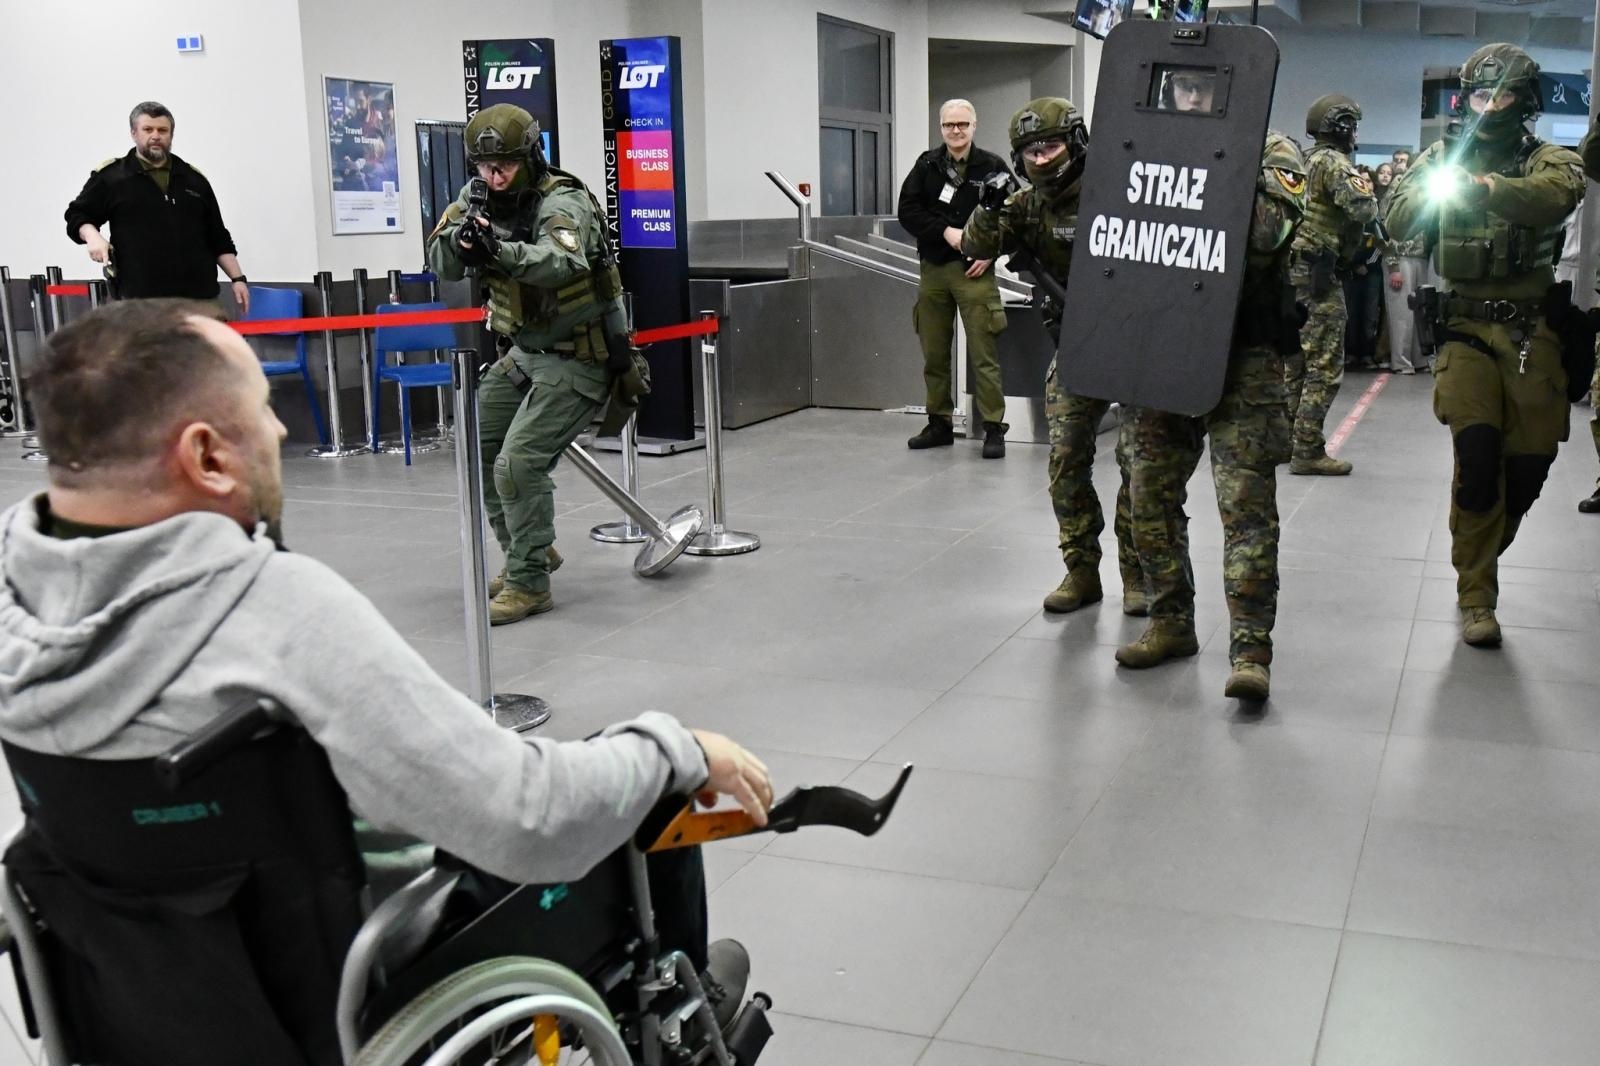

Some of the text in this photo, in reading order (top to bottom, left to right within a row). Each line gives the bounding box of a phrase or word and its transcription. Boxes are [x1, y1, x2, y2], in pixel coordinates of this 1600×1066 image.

[486, 66, 541, 90] LOT
[619, 65, 665, 89] LOT
[602, 70, 613, 119] GOLD
[344, 126, 363, 135] Travel
[624, 118, 664, 127] CHECK IN
[626, 149, 668, 159] BUSINESS
[641, 161, 669, 171] CLASS
[605, 140, 618, 232] ALLIANCE
[1126, 160, 1208, 211] STRAŻ
[631, 209, 671, 219] PREMIUM
[643, 222, 671, 232] CLASS
[1088, 214, 1226, 273] GRANICZNA
